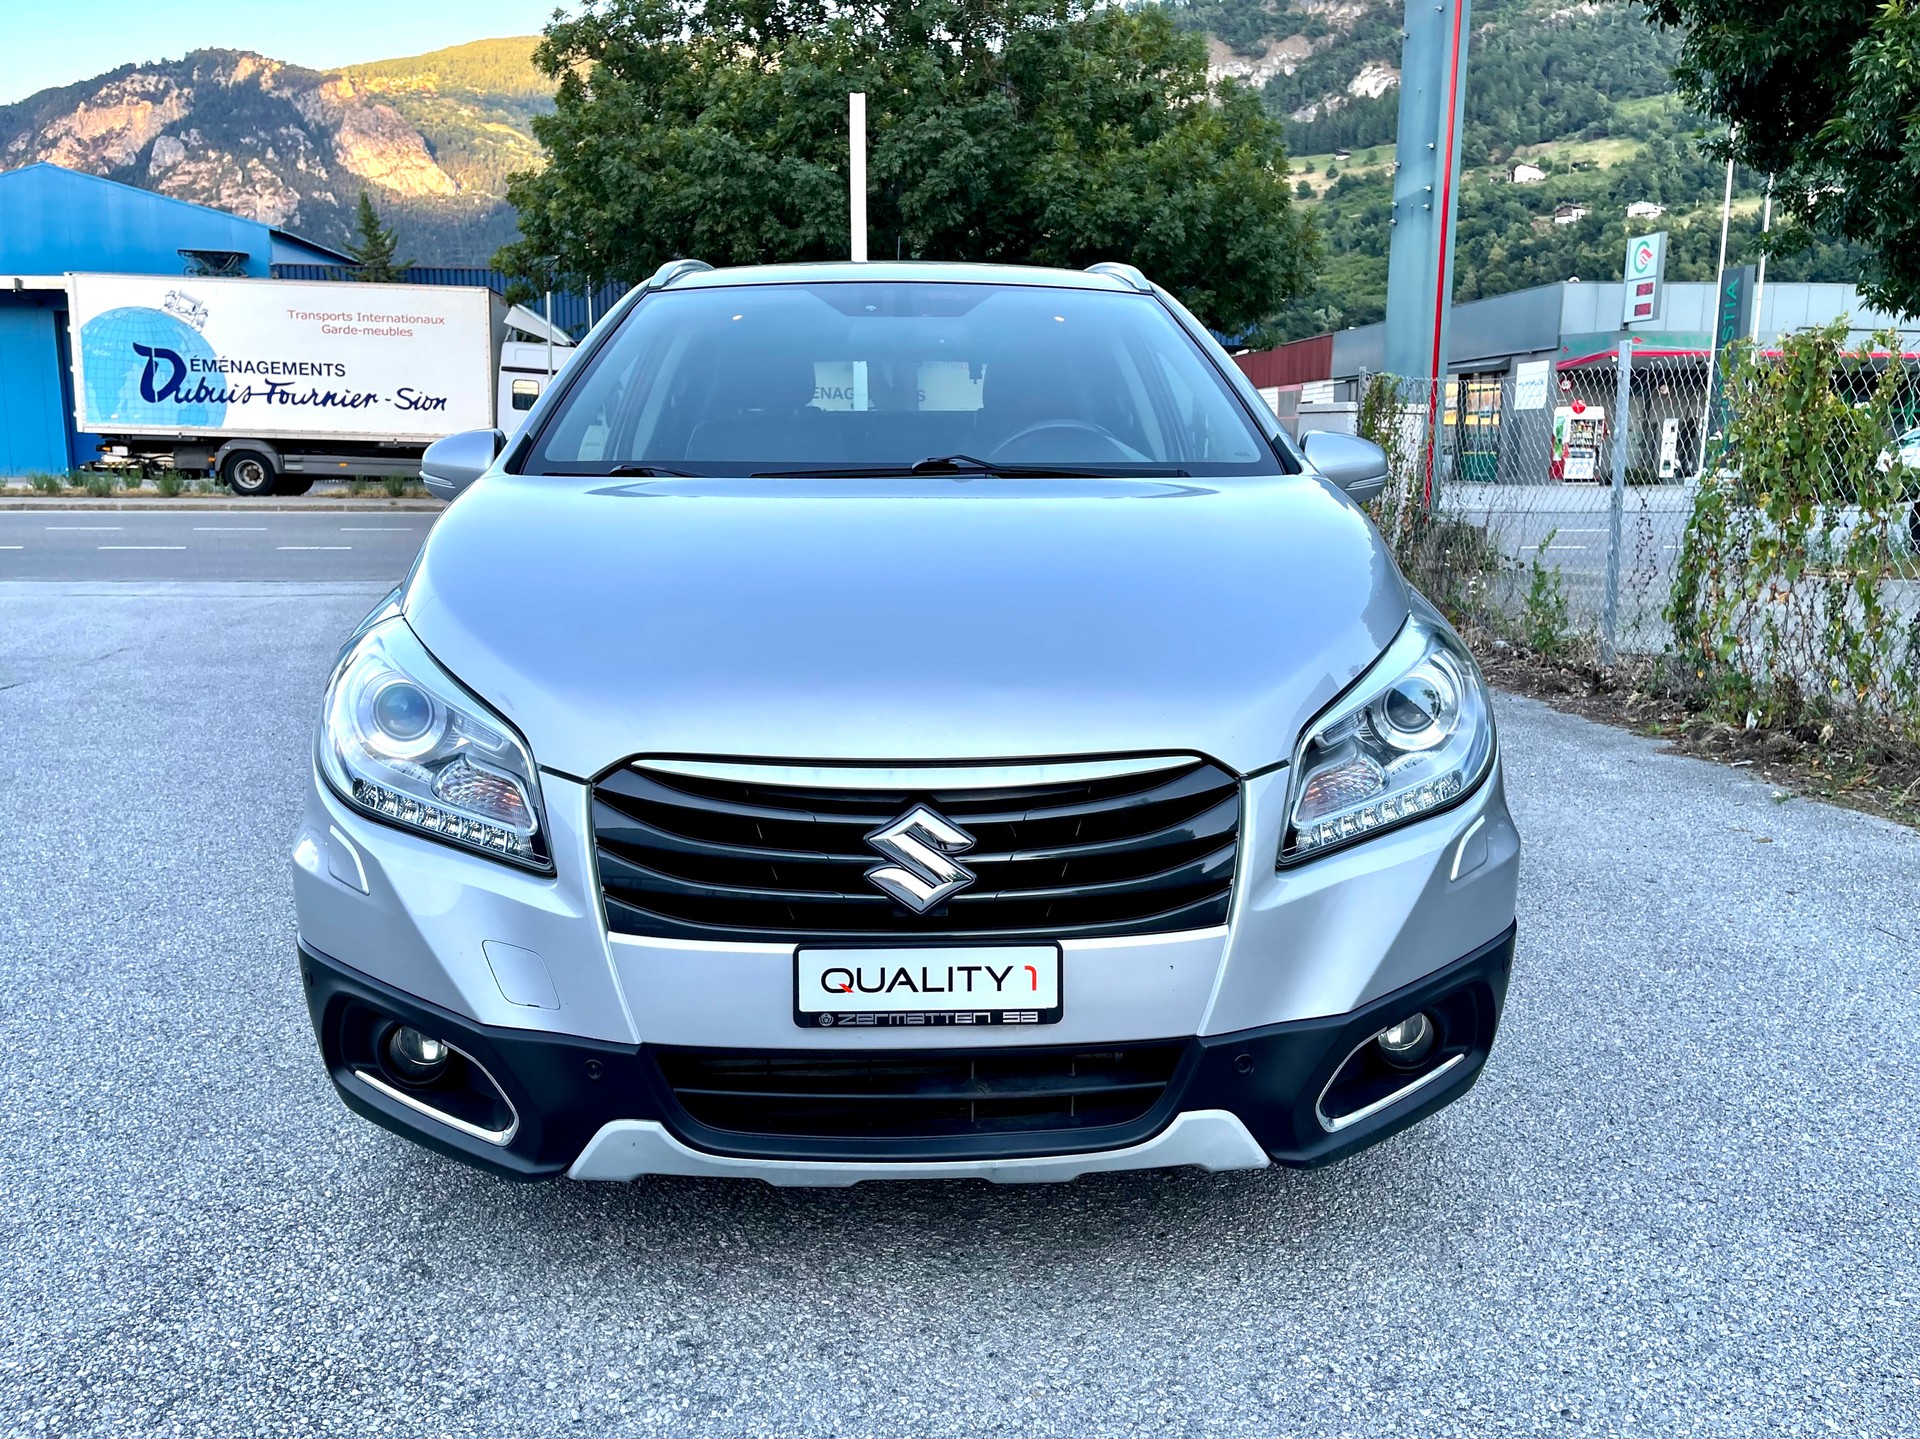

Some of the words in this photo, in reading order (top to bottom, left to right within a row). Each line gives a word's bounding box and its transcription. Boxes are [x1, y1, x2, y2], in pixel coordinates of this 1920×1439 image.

[287, 309, 353, 322] Transports
[357, 312, 445, 325] Internationaux
[1721, 275, 1740, 348] STIA
[321, 324, 413, 337] Garde-meubles
[820, 965, 1014, 994] QUALITY
[1024, 965, 1038, 991] 1
